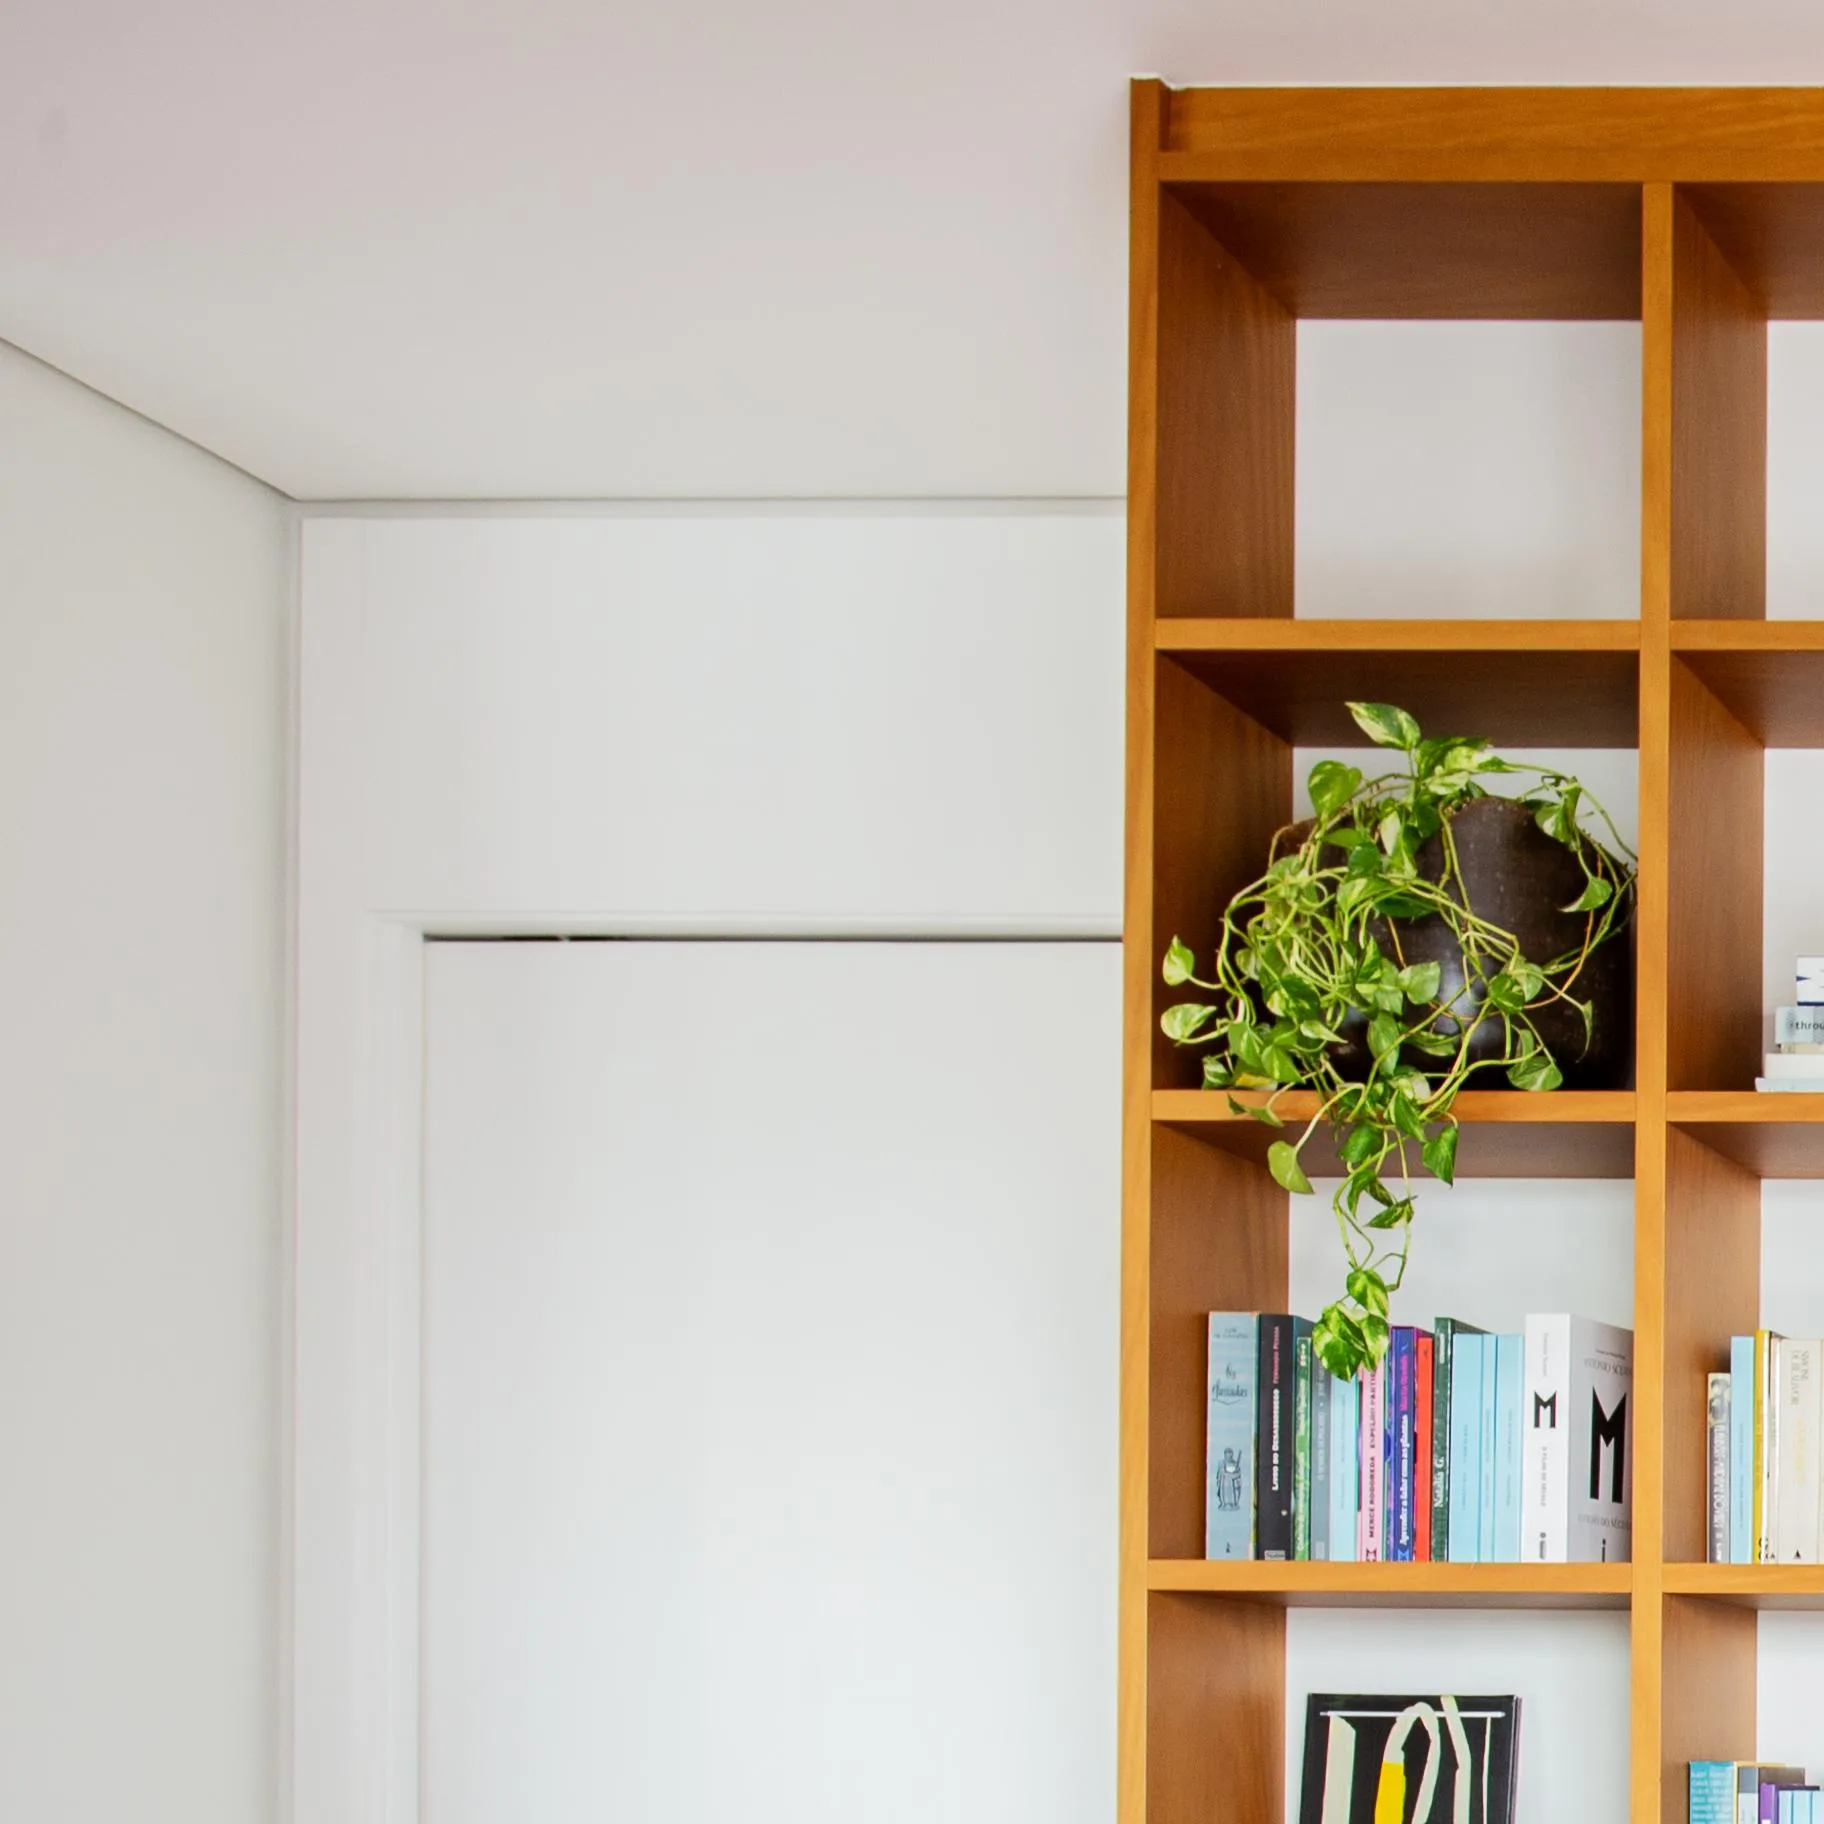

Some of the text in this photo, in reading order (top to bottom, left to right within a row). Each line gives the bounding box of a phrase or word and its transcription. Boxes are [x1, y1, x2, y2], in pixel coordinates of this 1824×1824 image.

[1534, 1391, 1557, 1428] M
[1589, 1386, 1627, 1504] M
[1368, 1456, 1376, 1505] RODOREDA
